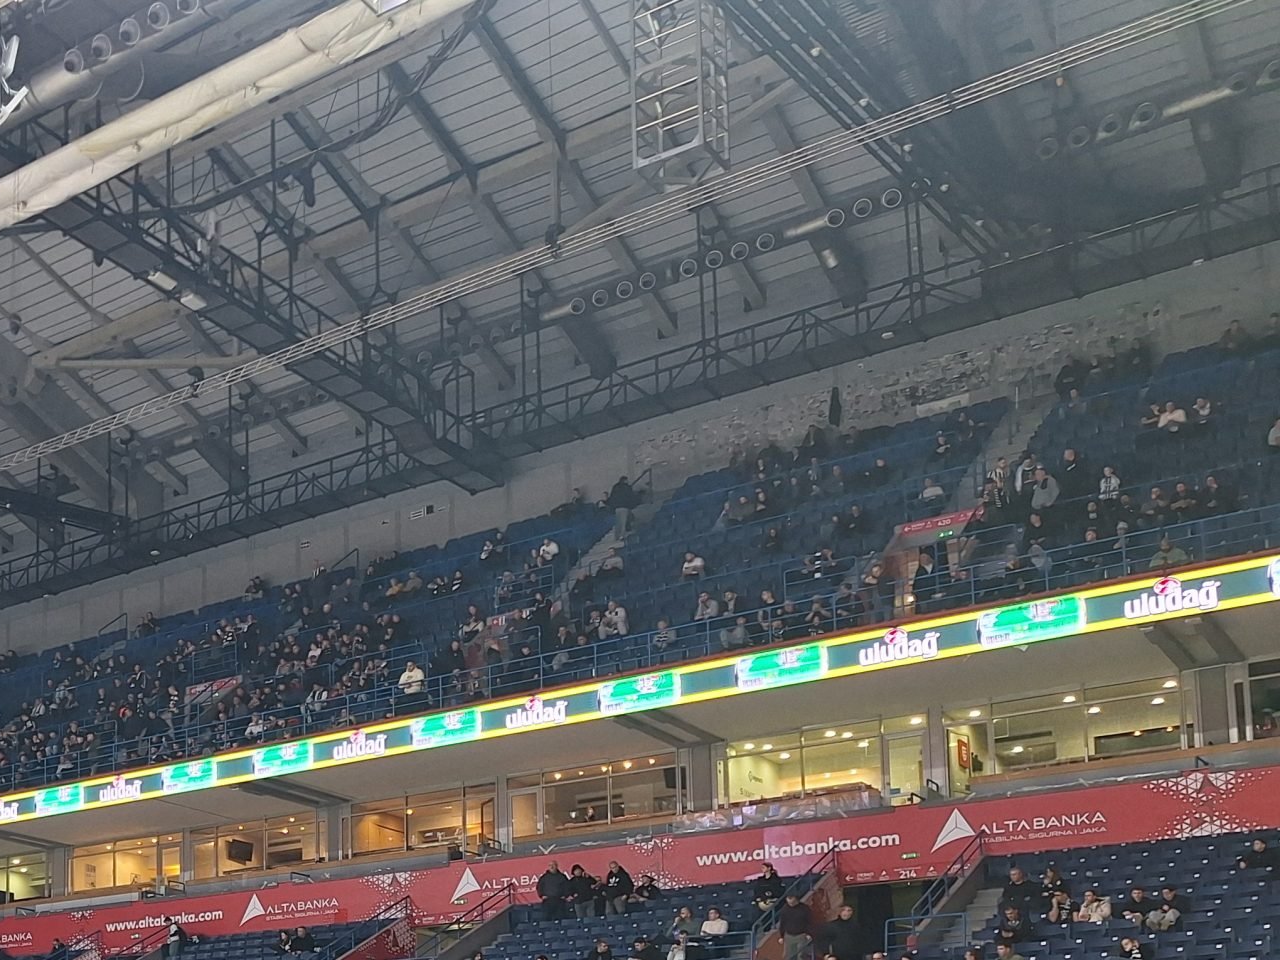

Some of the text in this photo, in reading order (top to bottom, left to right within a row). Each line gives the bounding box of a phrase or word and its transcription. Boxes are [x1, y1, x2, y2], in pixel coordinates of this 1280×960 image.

[1124, 579, 1221, 620] uludağ
[858, 631, 941, 667] uludağ
[505, 699, 568, 730] uludağ
[333, 733, 387, 761] uludağ
[100, 778, 142, 801] uludağ
[979, 811, 1107, 835] ALTABANKA
[695, 832, 901, 867] www.altabanka.com
[899, 870, 917, 880] 214
[266, 897, 339, 914] ALTABANKA
[105, 909, 223, 933] www.altabnka.com
